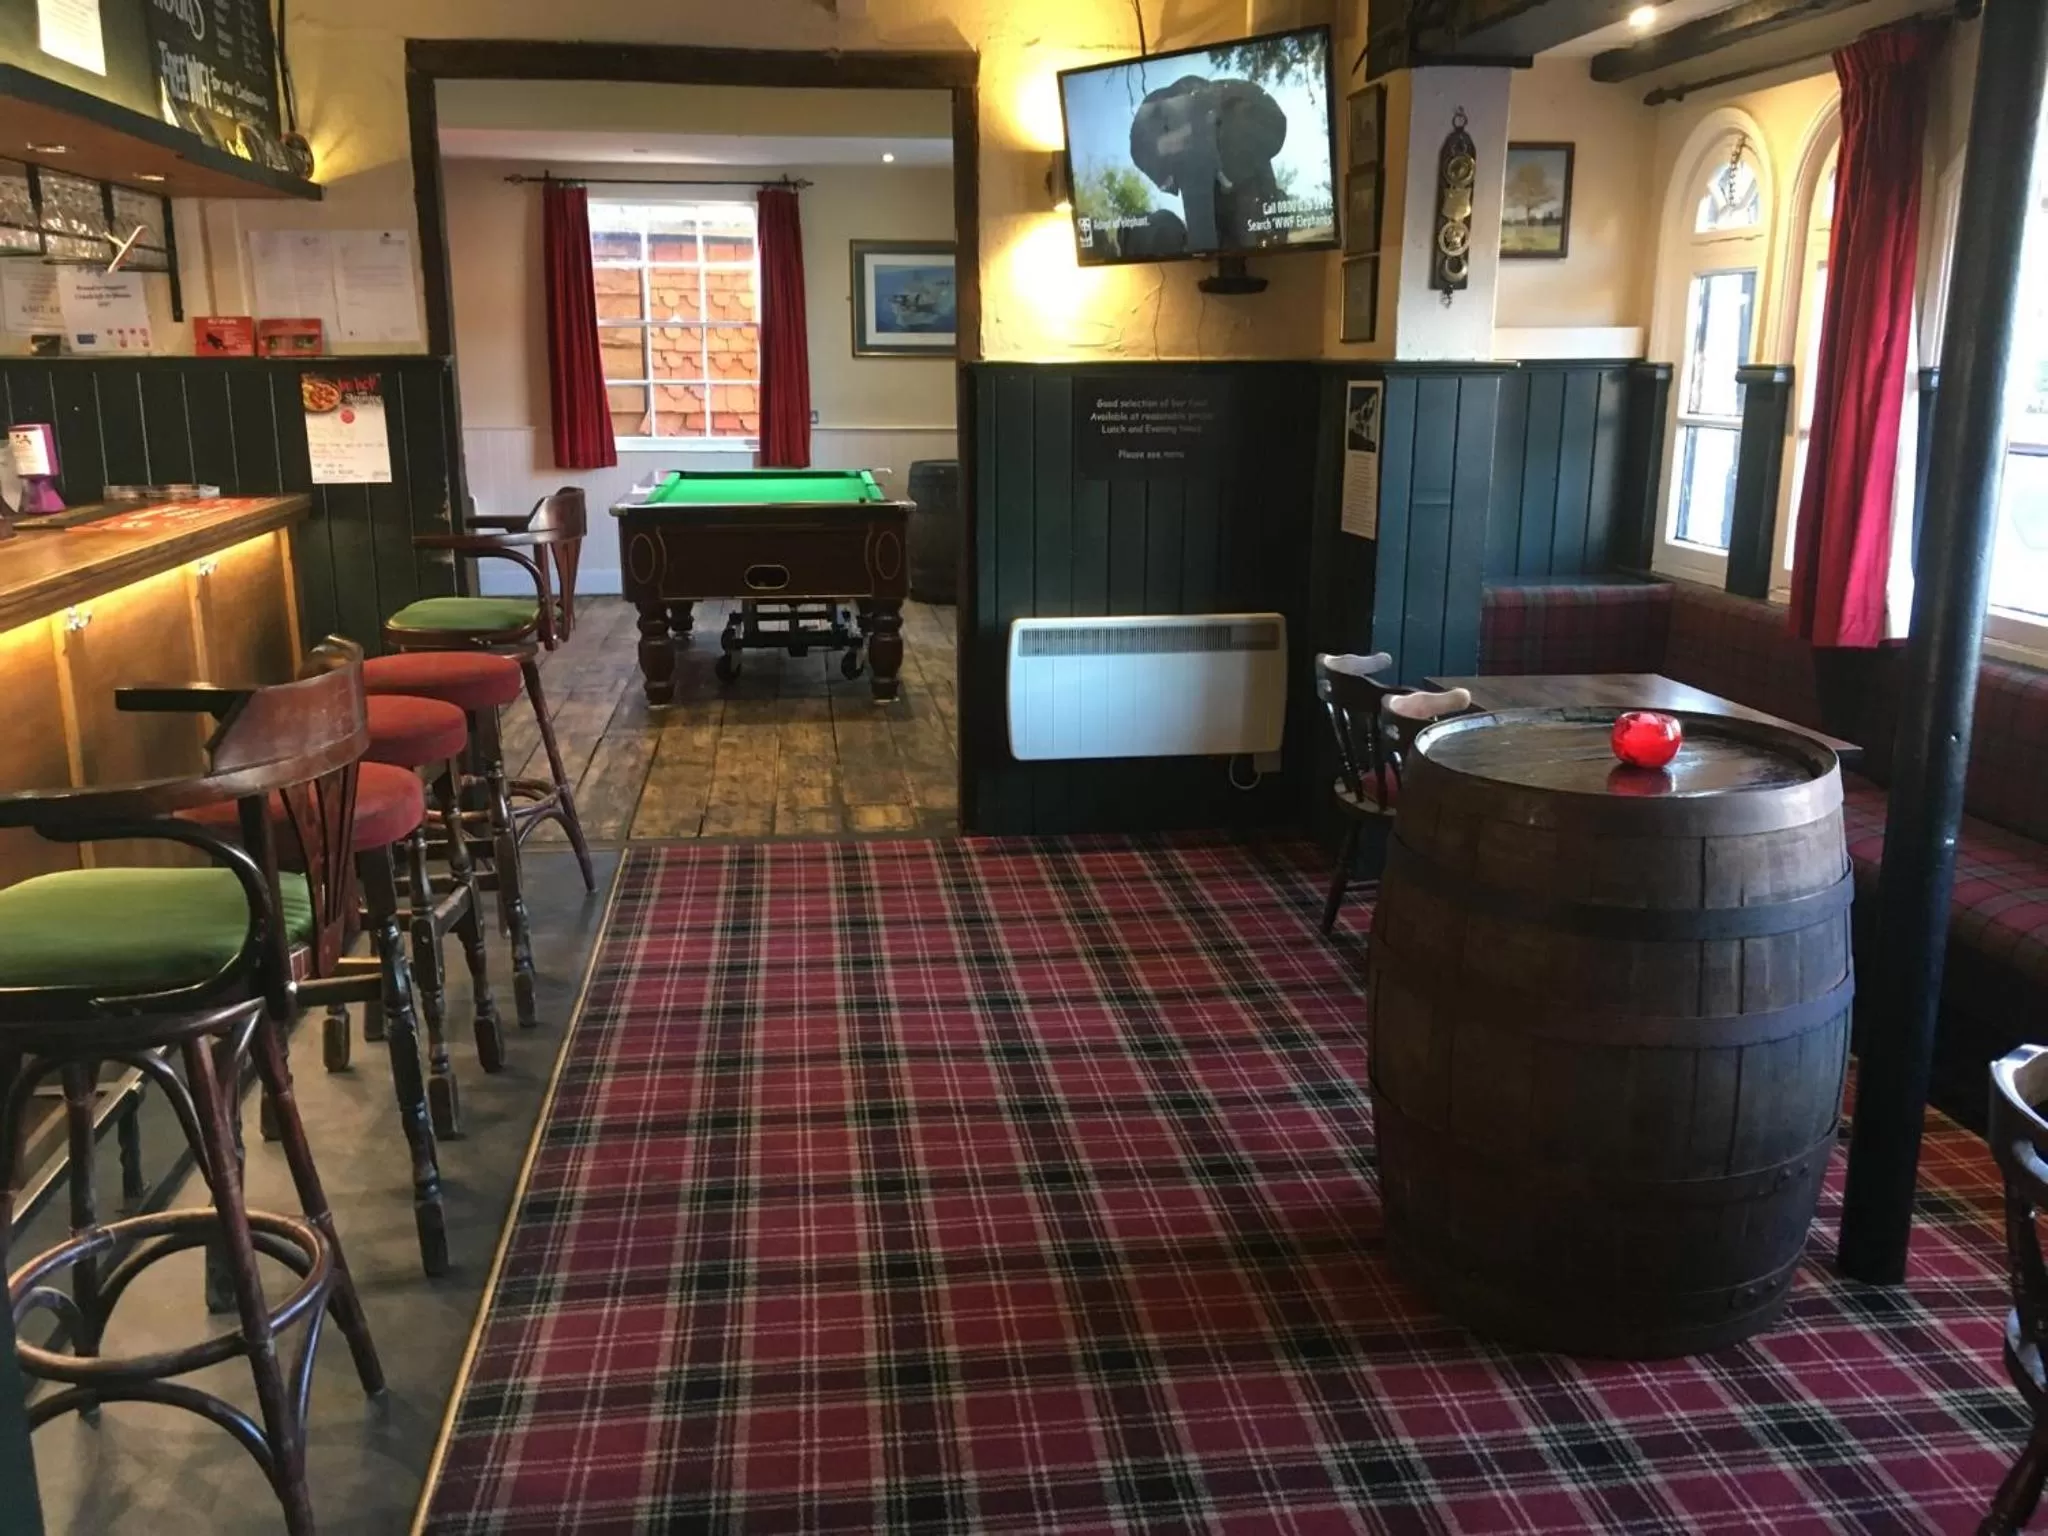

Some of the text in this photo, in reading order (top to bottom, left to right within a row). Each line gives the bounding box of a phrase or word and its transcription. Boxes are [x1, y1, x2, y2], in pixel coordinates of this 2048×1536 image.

[1262, 201, 1276, 215] Call
[1247, 217, 1272, 232] Search
[1096, 398, 1118, 408] Good
[1119, 397, 1158, 409] selection
[1090, 412, 1128, 422] Available
[1129, 412, 1140, 421] at
[1101, 424, 1127, 434] Lunch
[1128, 424, 1143, 434] and
[1144, 424, 1178, 436] Evening
[1117, 449, 1145, 460] Please
